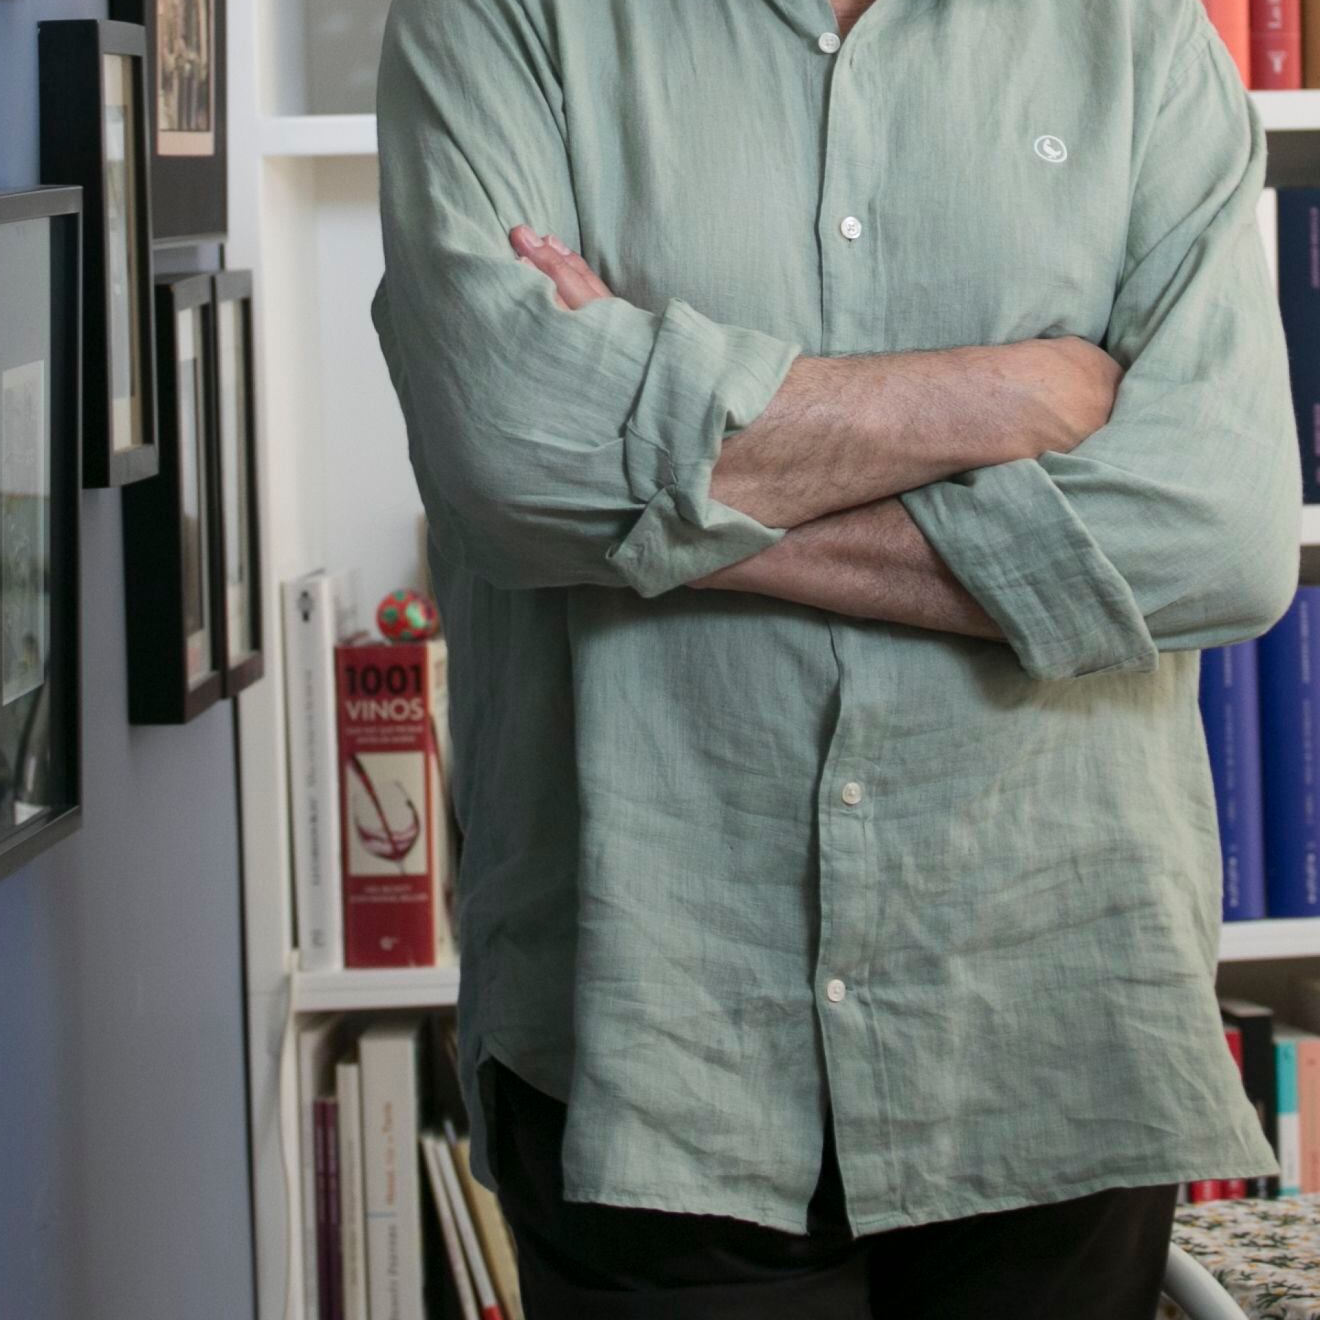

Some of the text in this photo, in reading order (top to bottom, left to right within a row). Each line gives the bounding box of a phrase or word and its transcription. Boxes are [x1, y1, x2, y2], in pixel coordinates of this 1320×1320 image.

[1267, 6, 1282, 30] Las
[344, 663, 425, 698] 1001
[344, 697, 424, 722] VINOS
